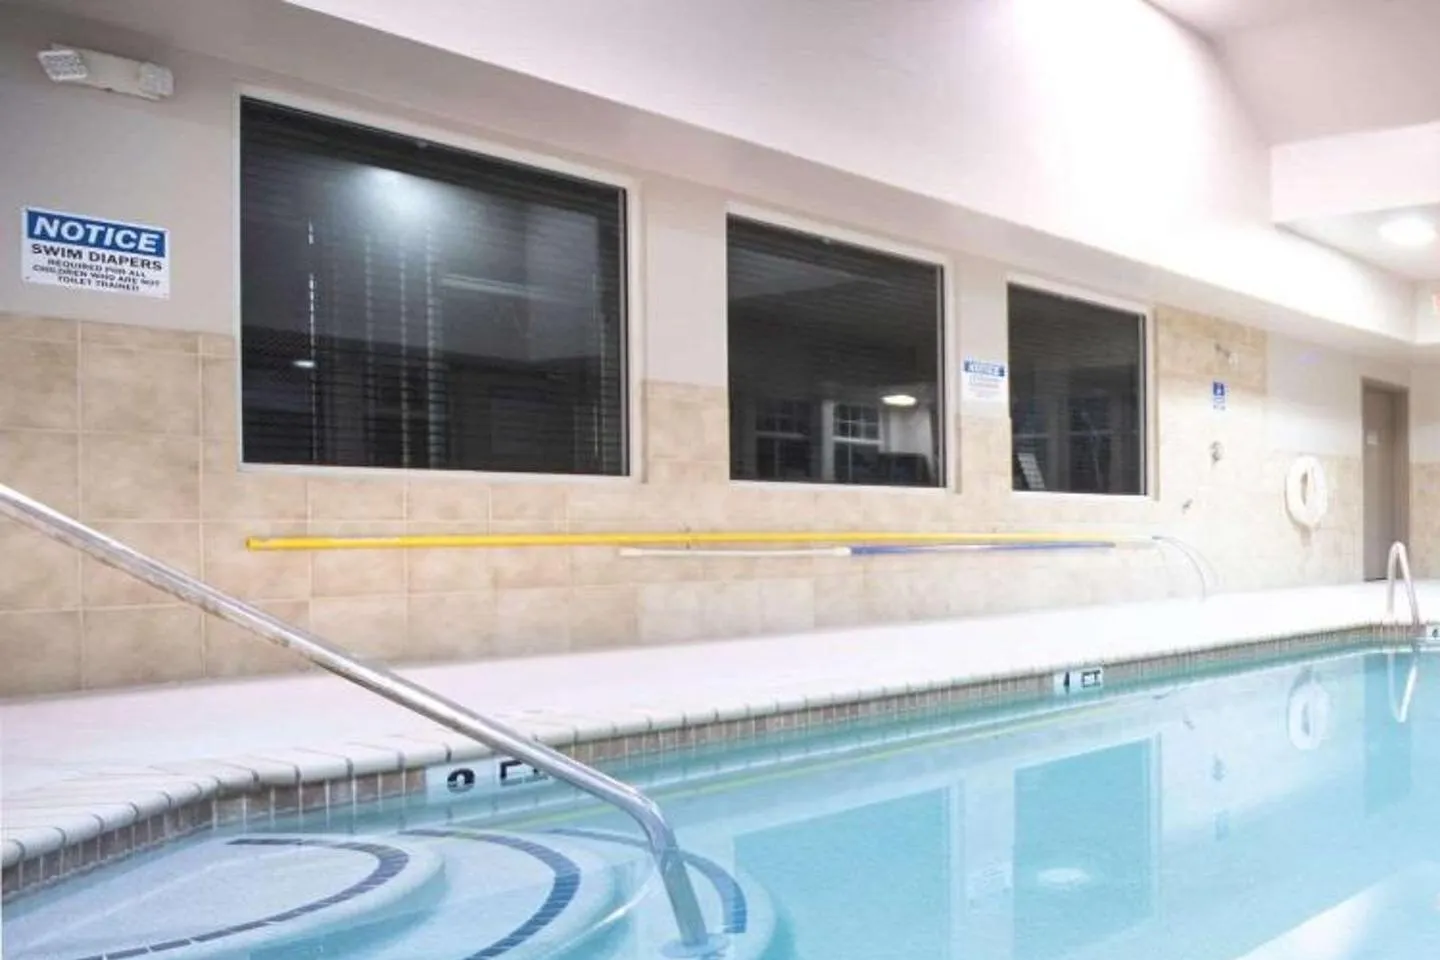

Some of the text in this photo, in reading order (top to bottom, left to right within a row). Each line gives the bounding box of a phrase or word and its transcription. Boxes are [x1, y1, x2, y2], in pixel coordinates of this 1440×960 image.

[34, 216, 160, 252] NOTICE
[32, 243, 163, 271] SWIM DIAPERS
